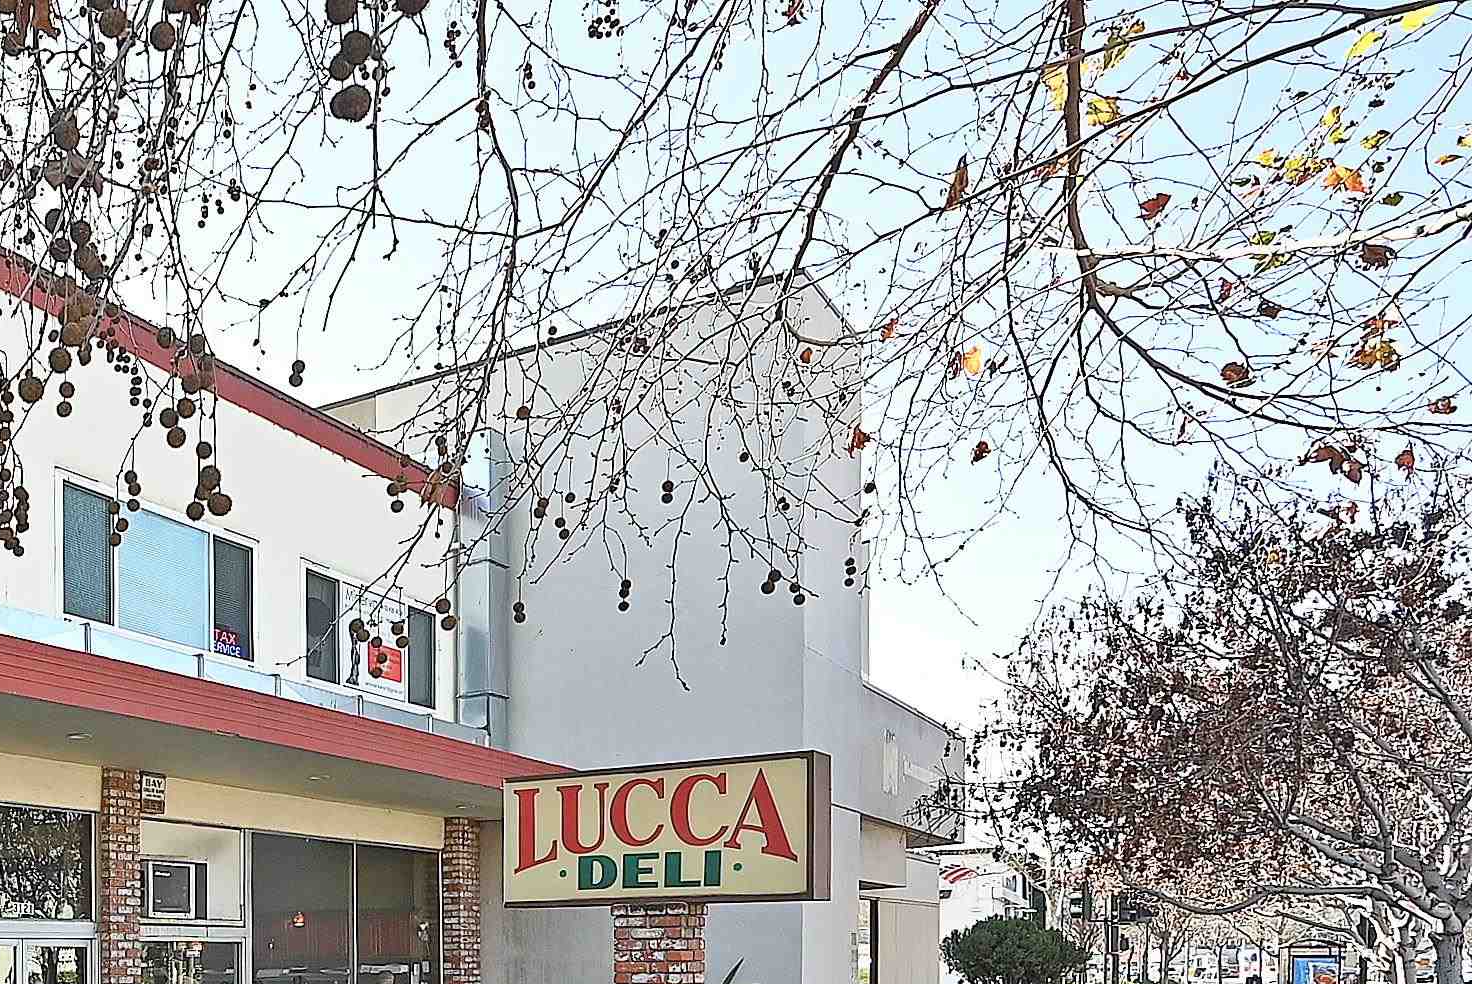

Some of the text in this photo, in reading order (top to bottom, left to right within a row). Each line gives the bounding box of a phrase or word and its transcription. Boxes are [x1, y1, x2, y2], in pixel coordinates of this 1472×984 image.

[213, 641, 241, 658] ERVICE
[214, 629, 236, 645] TAX
[514, 768, 798, 875] LUCCA
[578, 850, 722, 890] DELI
